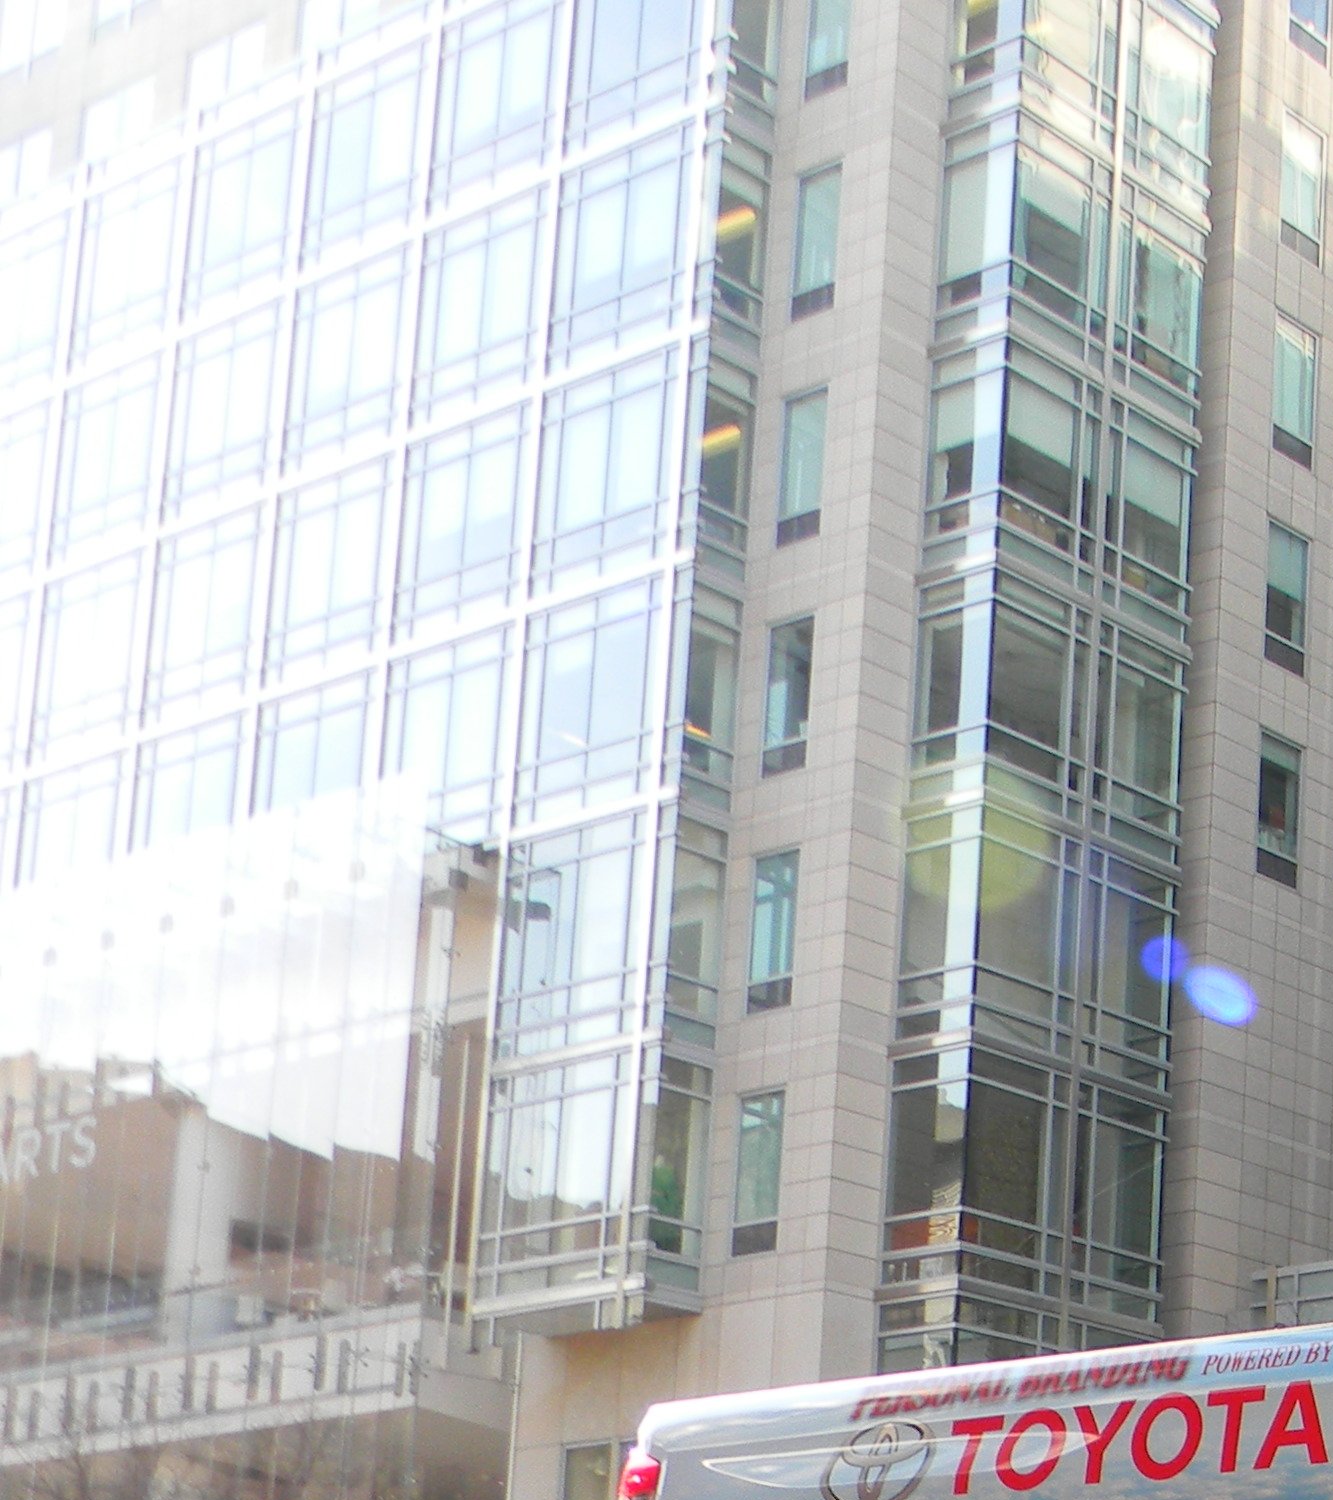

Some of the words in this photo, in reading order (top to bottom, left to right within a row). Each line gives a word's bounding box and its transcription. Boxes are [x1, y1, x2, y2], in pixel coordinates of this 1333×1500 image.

[0, 1115, 97, 1184] RTS
[1202, 1344, 1300, 1376] POWERED
[951, 1381, 1329, 1495] TOYOTA
